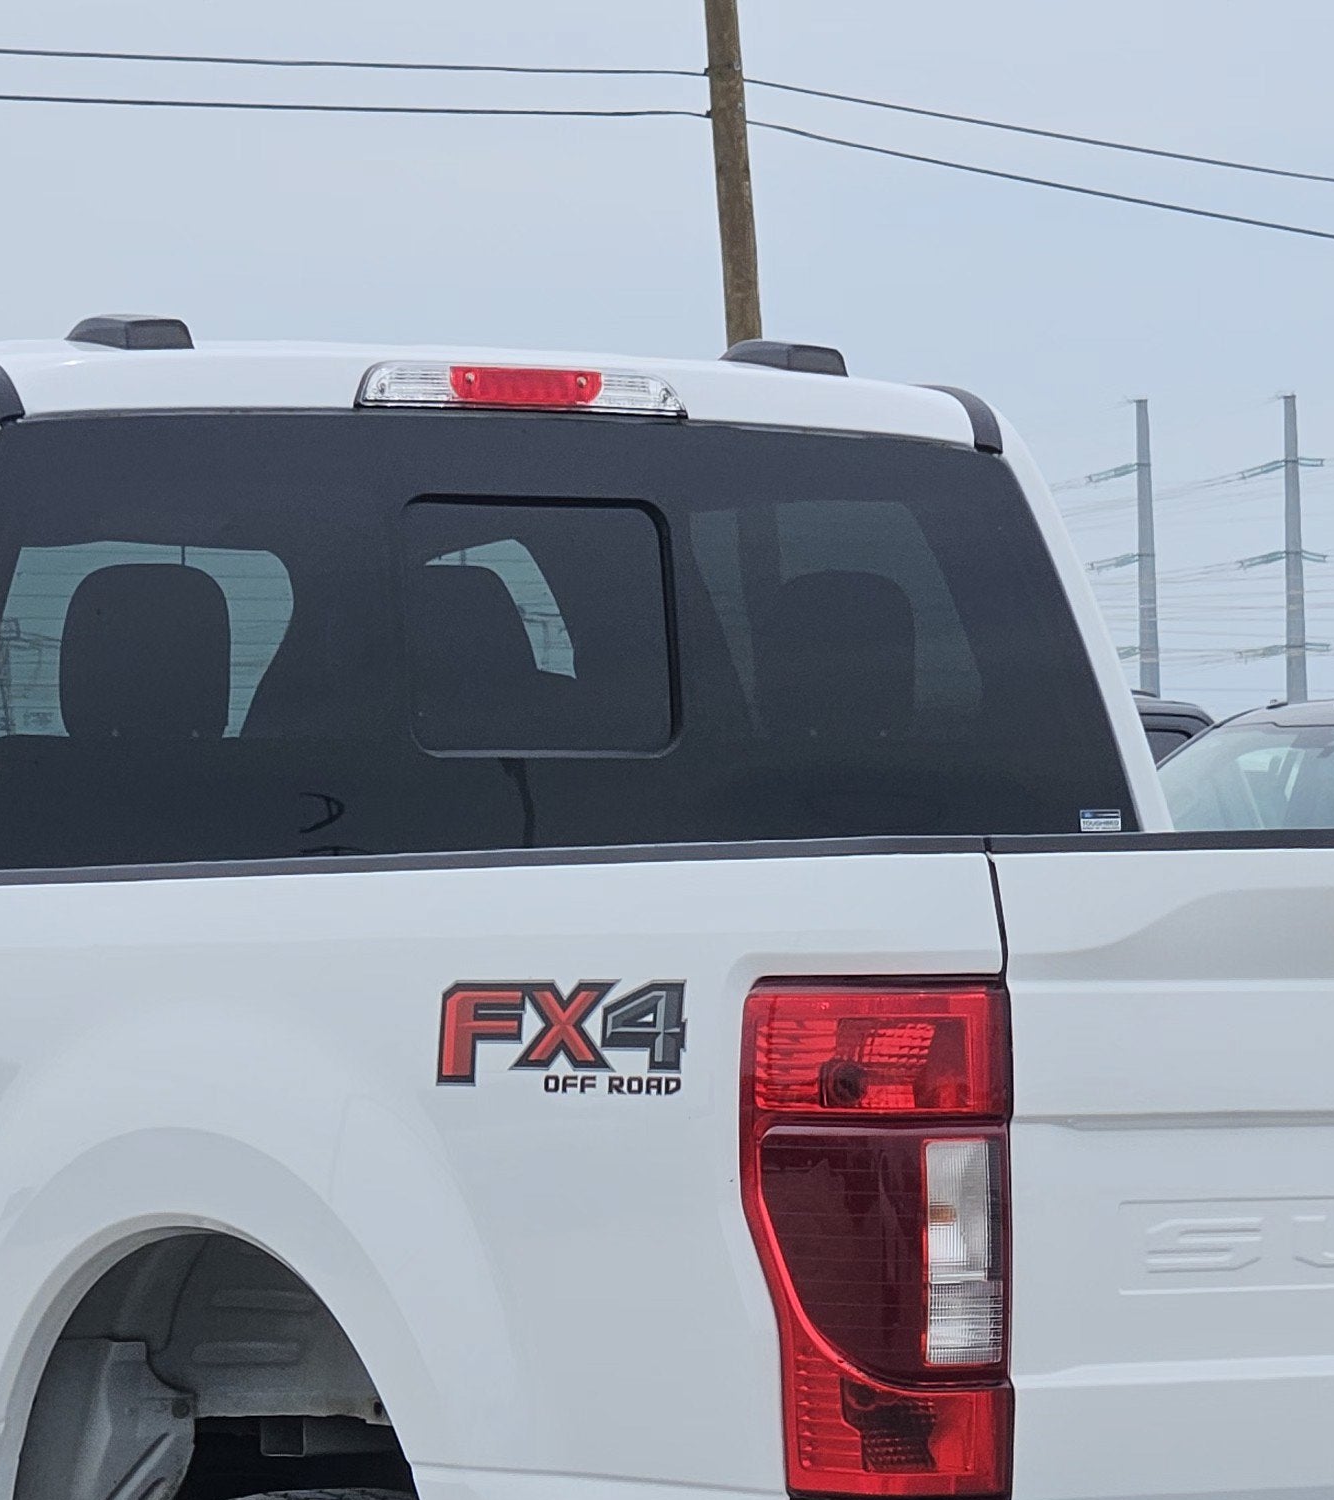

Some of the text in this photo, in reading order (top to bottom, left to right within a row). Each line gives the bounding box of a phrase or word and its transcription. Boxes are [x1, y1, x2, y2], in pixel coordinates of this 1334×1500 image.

[436, 979, 686, 1086] FX4
[543, 1074, 682, 1096] OFF ROAD
